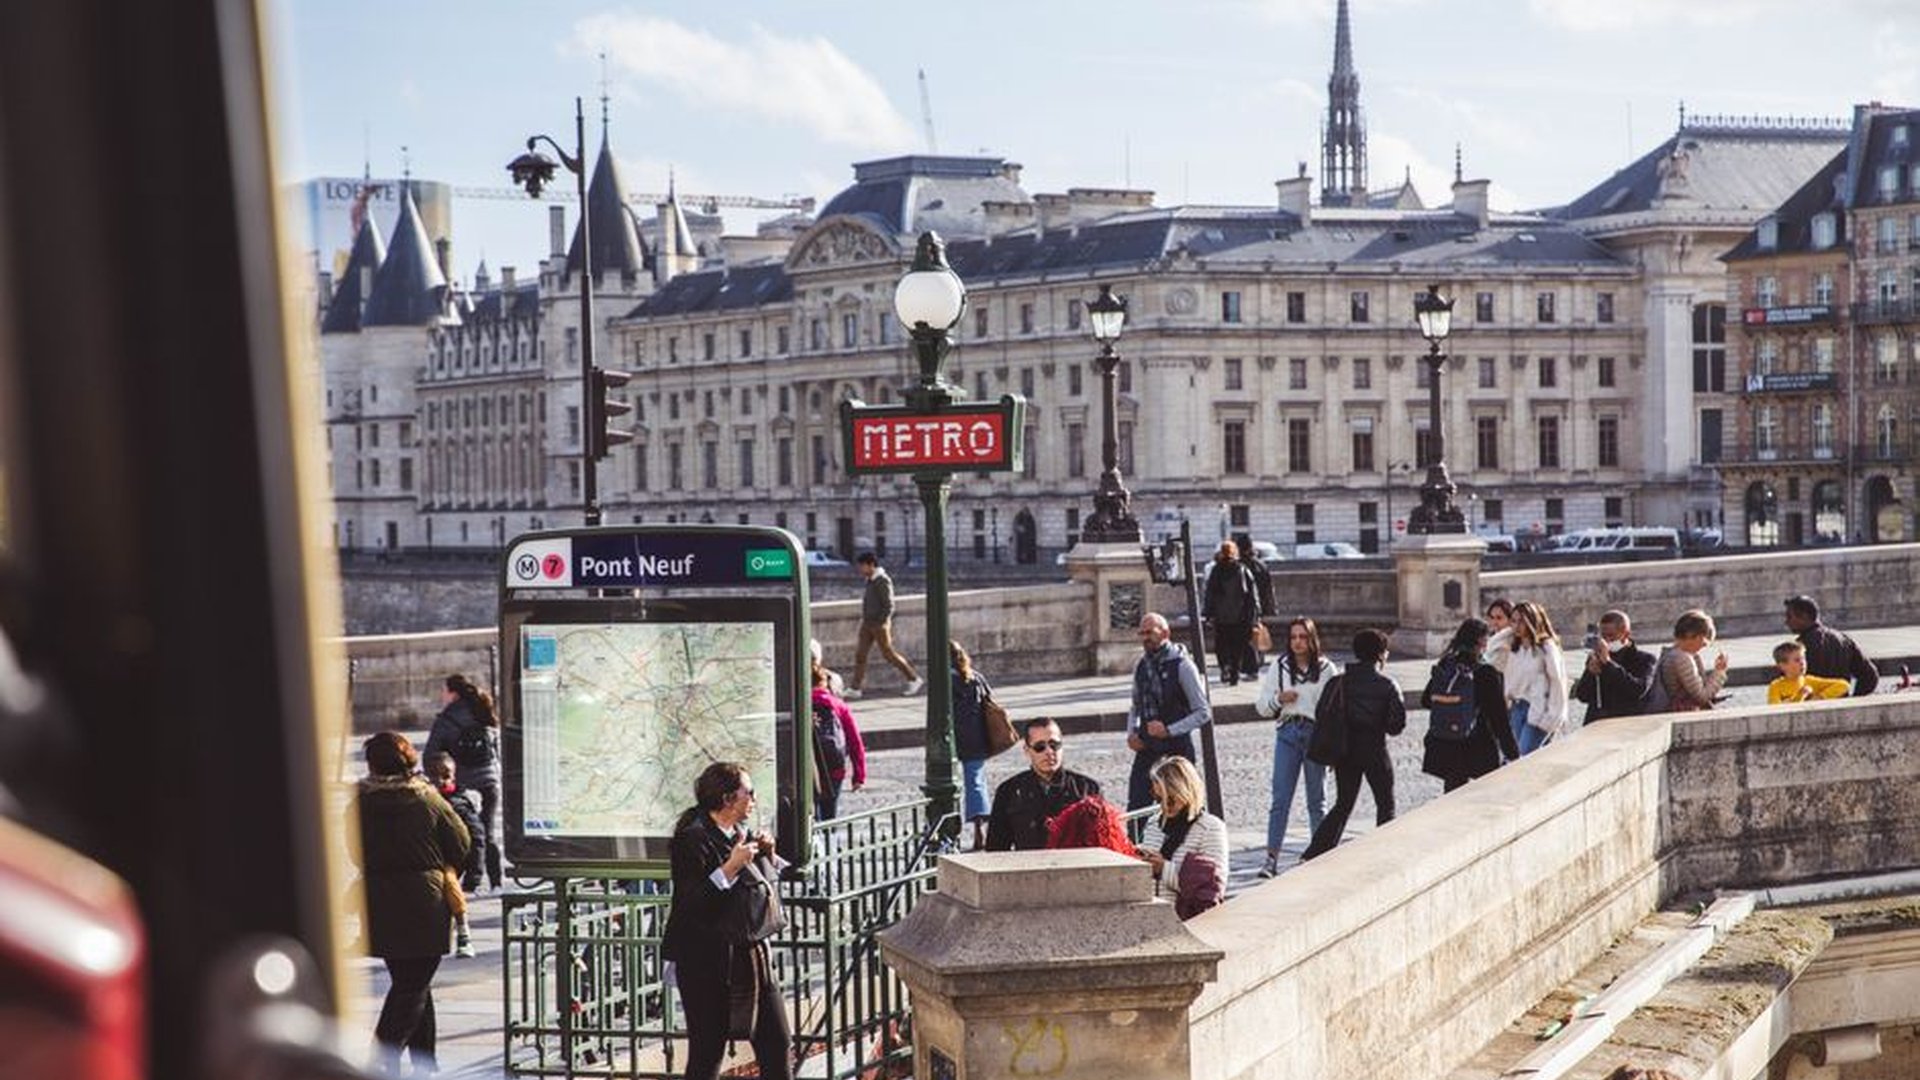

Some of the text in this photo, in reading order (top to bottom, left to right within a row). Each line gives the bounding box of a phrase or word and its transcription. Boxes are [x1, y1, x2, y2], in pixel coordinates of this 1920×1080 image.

[864, 421, 994, 459] METRO
[548, 558, 559, 575] 7
[581, 556, 632, 577] Pont
[639, 554, 695, 577] Neuf
